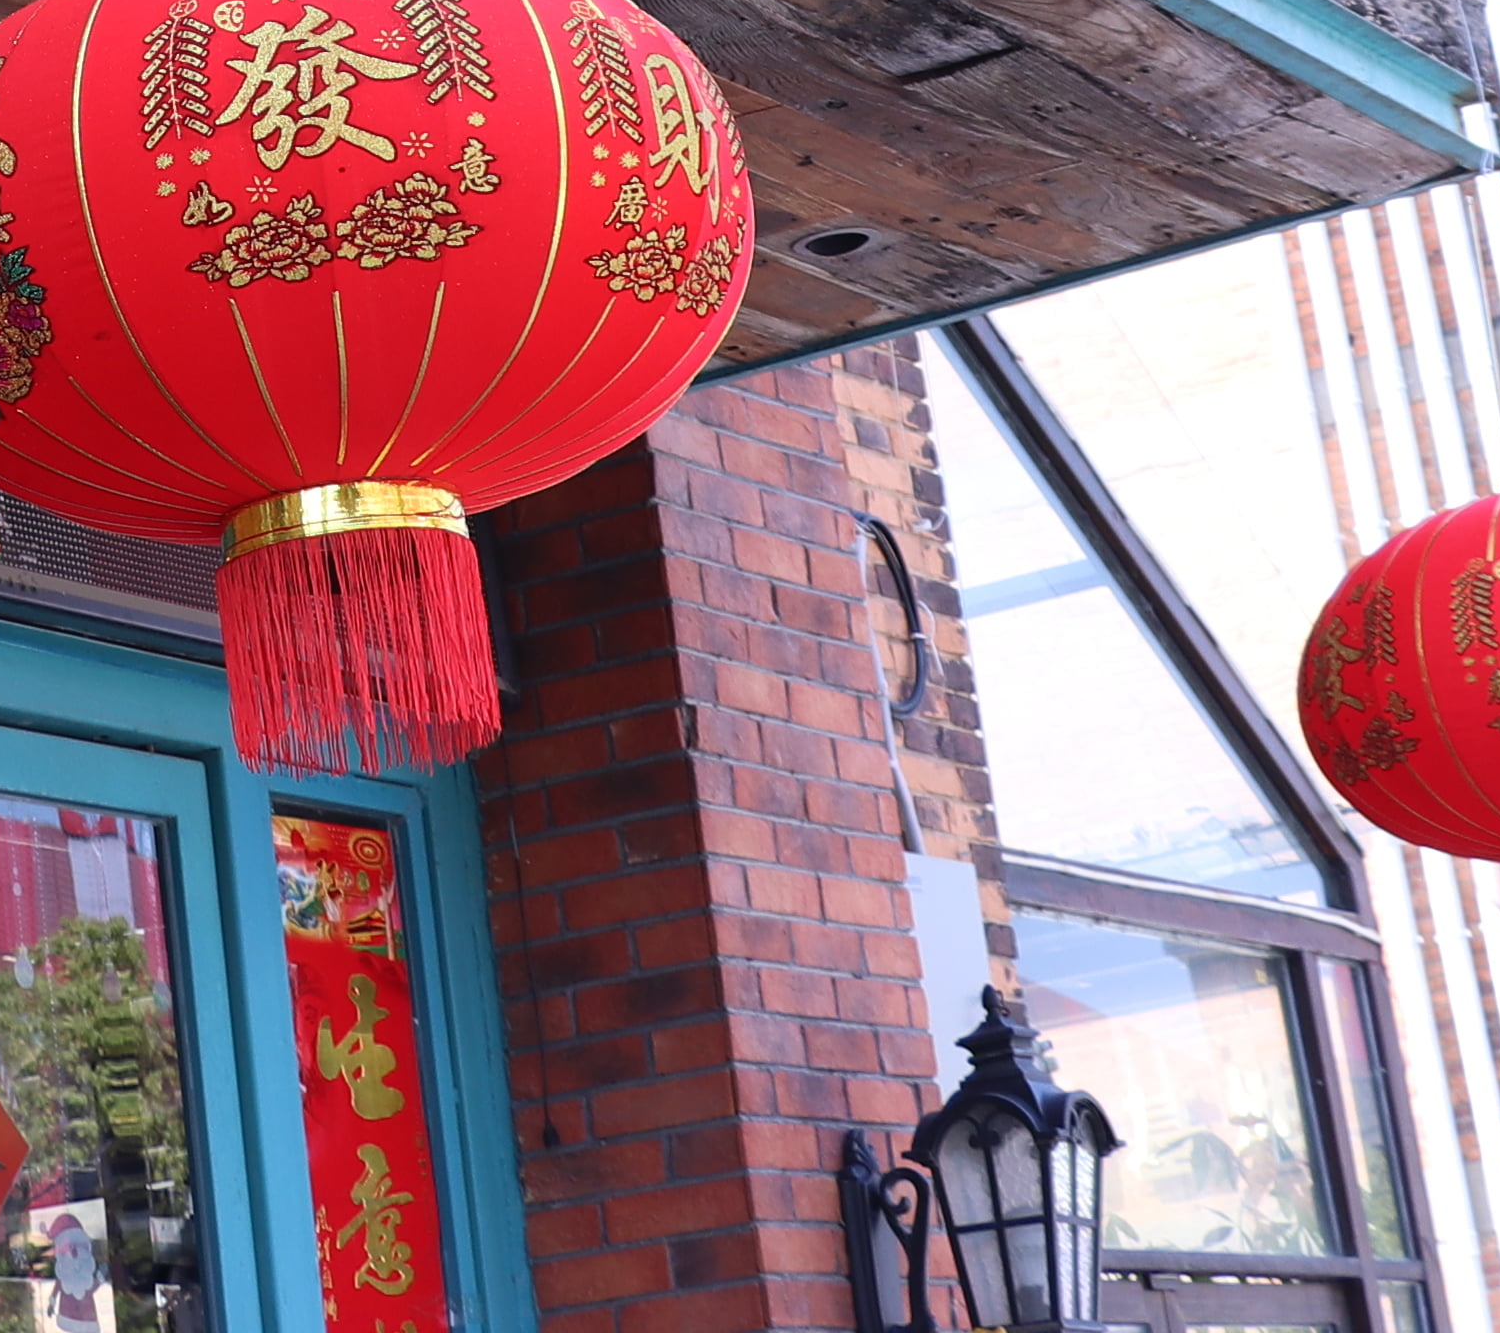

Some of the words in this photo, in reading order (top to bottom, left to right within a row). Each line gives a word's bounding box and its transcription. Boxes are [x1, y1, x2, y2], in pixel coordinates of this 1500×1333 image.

[214, 4, 420, 171] 發
[450, 137, 500, 194] 意
[318, 973, 418, 1333] 生意
